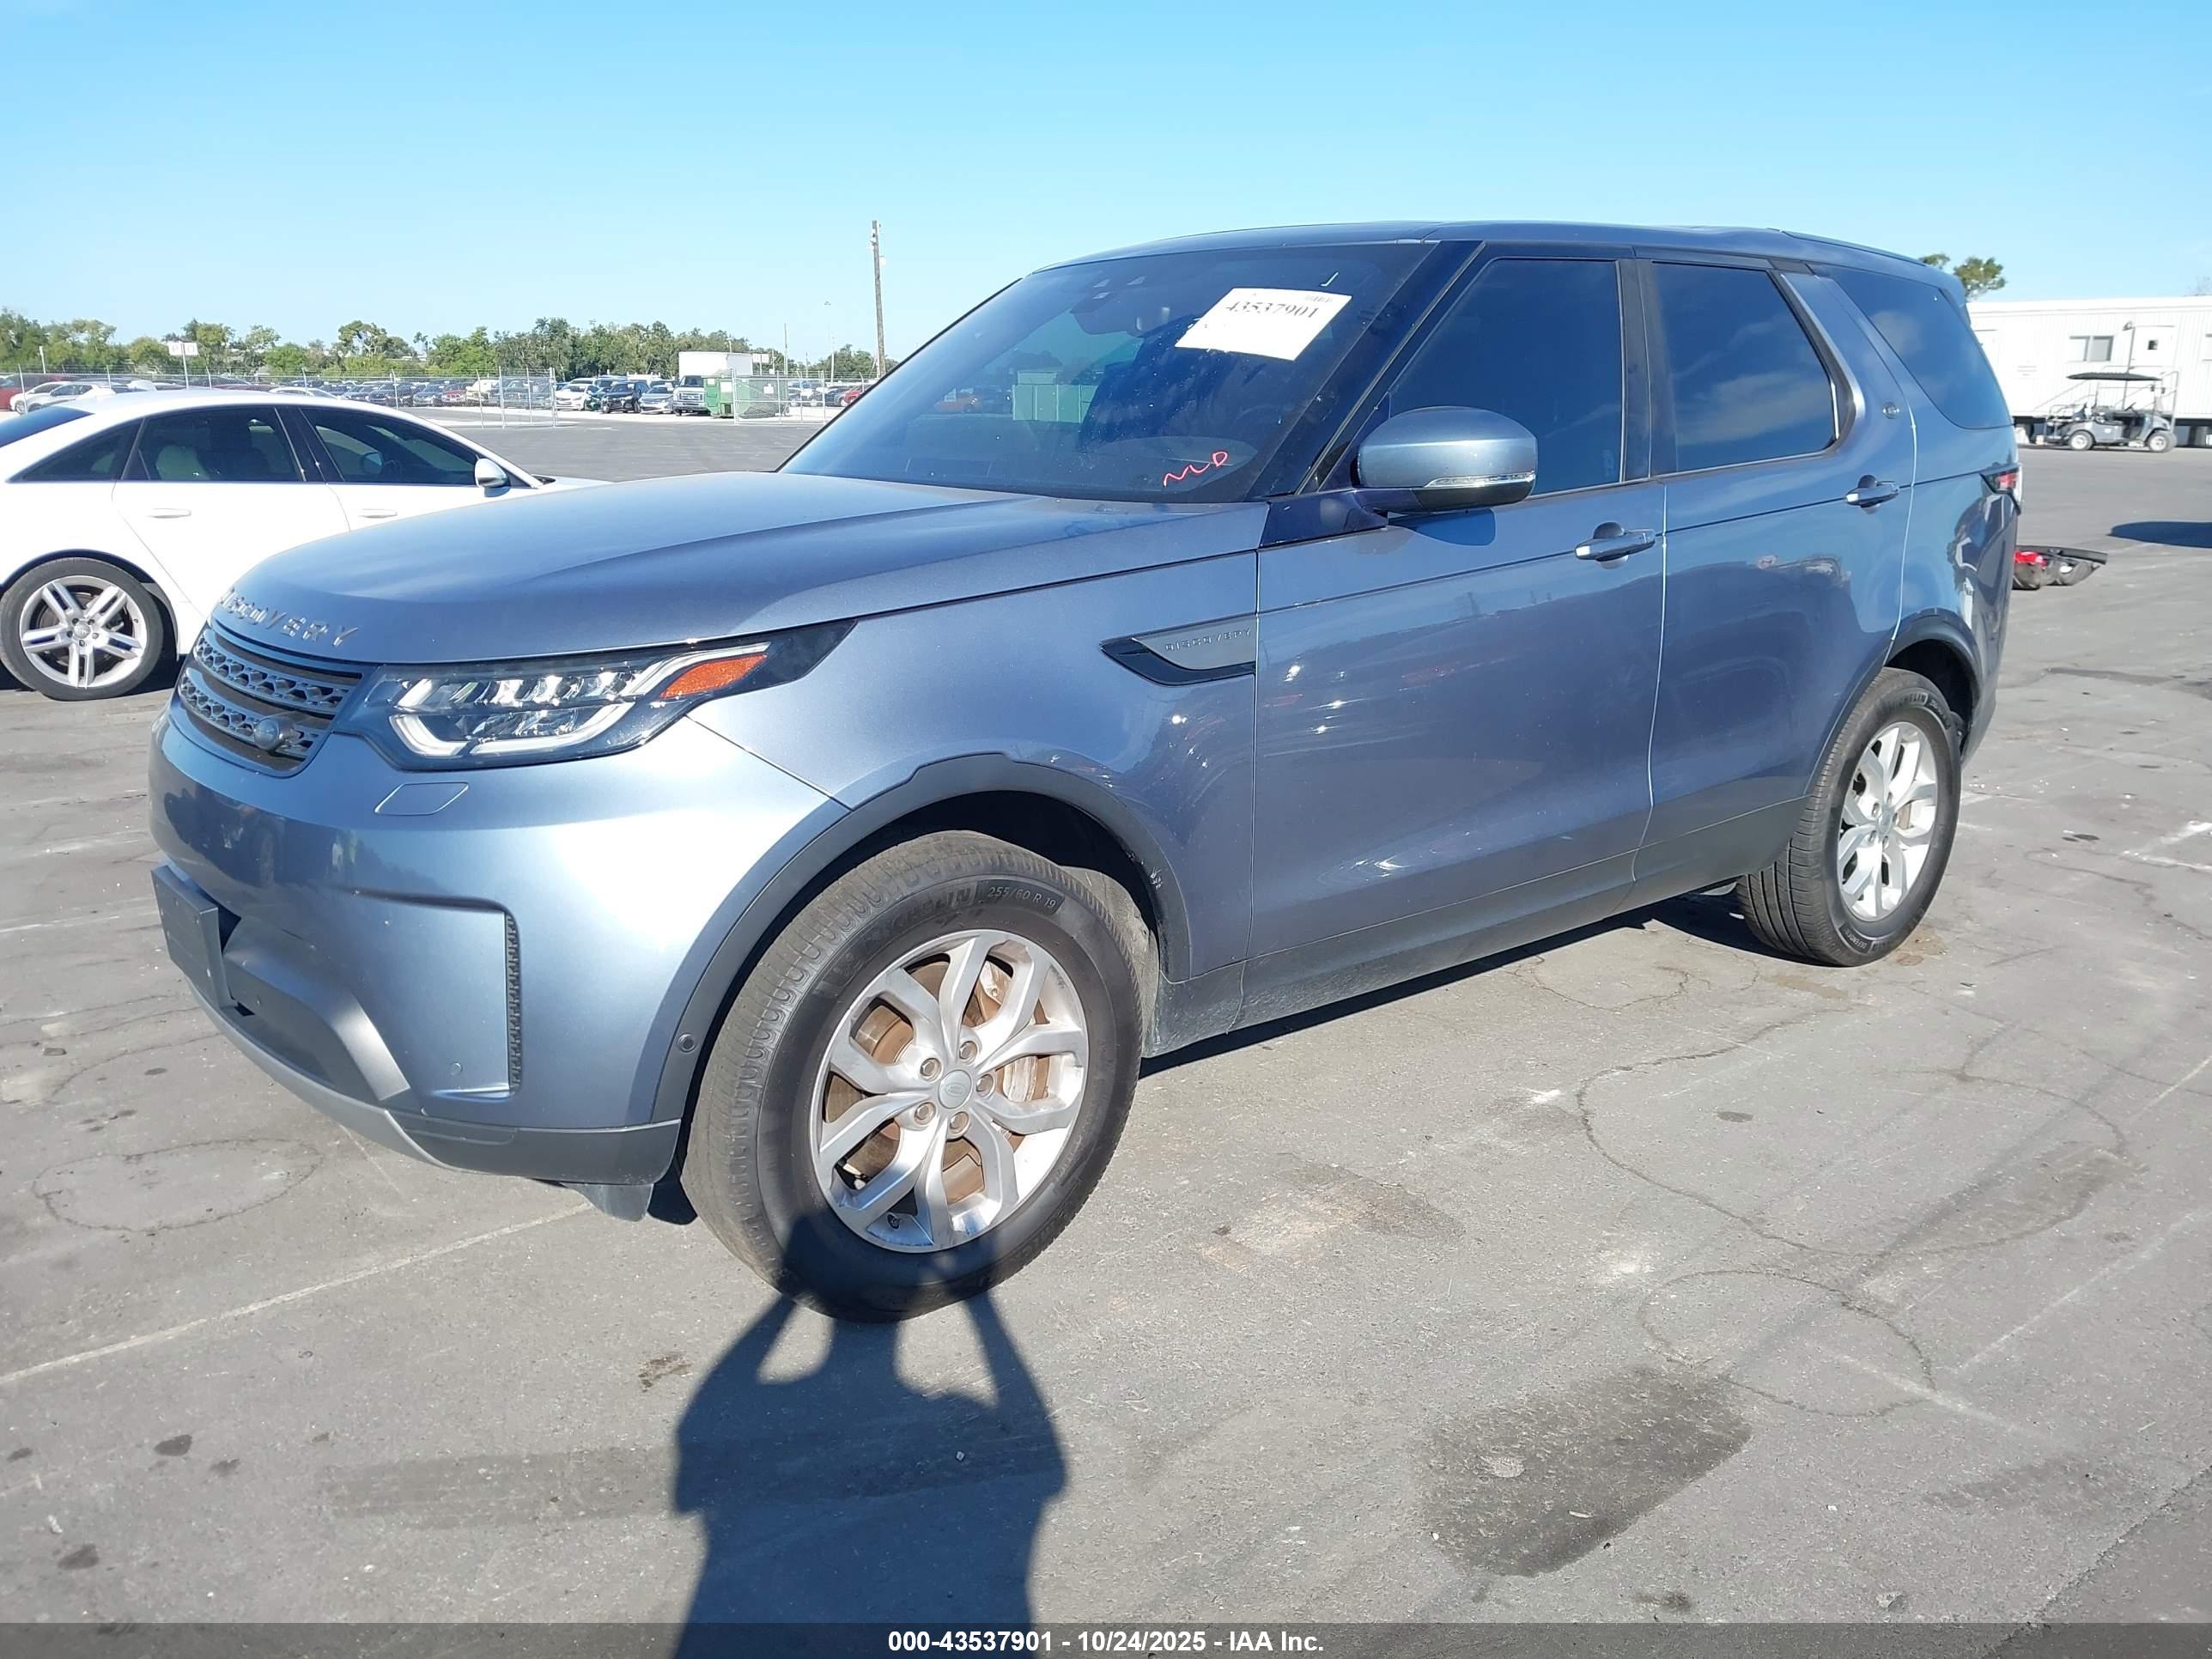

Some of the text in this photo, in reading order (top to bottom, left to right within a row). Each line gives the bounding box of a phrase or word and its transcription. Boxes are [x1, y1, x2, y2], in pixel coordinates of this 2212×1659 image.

[1225, 301, 1319, 319] 43537901
[987, 886, 1030, 901] 255/60
[1033, 893, 1042, 903] R
[1042, 896, 1057, 908] 19
